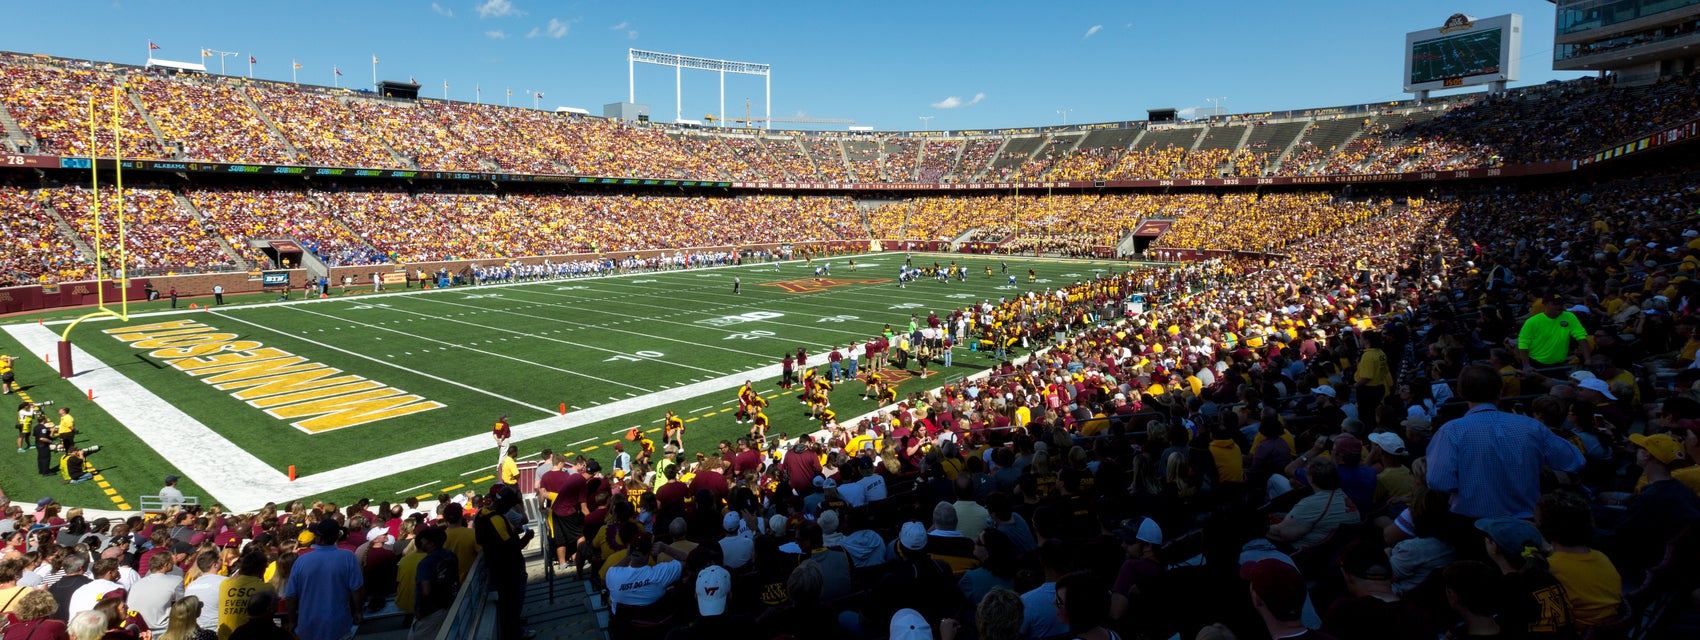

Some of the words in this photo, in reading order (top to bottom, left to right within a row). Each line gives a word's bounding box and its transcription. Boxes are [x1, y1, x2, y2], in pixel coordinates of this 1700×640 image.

[7, 156, 24, 164] 78
[723, 330, 776, 340] 20
[603, 350, 664, 362] 10
[103, 319, 447, 435] MINNESOTA
[620, 582, 633, 591] JUST
[228, 588, 255, 597] CSC
[704, 587, 719, 596] VT
[762, 590, 786, 600] BANK
